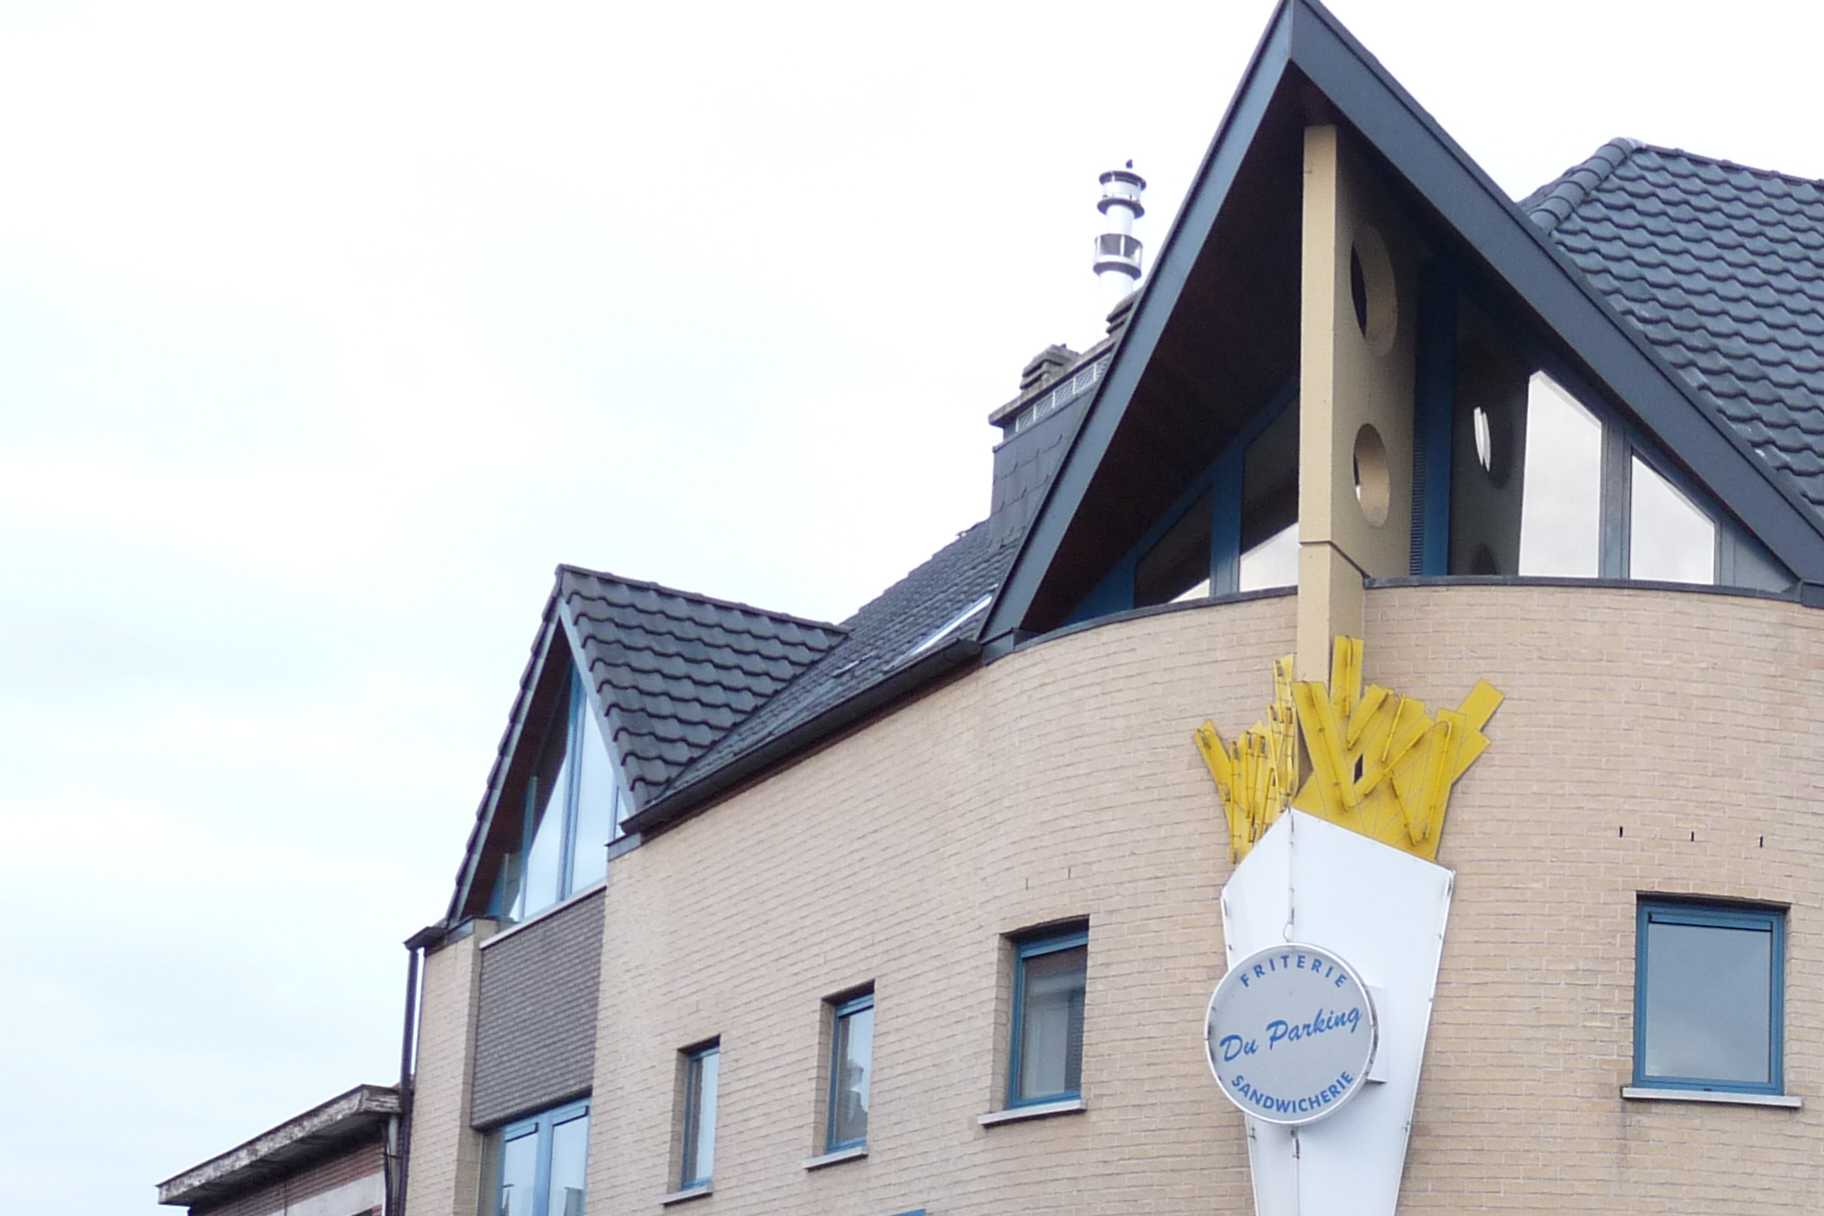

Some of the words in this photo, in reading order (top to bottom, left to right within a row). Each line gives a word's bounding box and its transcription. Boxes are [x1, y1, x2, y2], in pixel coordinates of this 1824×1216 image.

[1240, 955, 1348, 988] FRITERIE
[1219, 1034, 1259, 1062] Du
[1265, 1006, 1362, 1050] Parking
[1231, 1071, 1354, 1114] SANDWICHERIE
